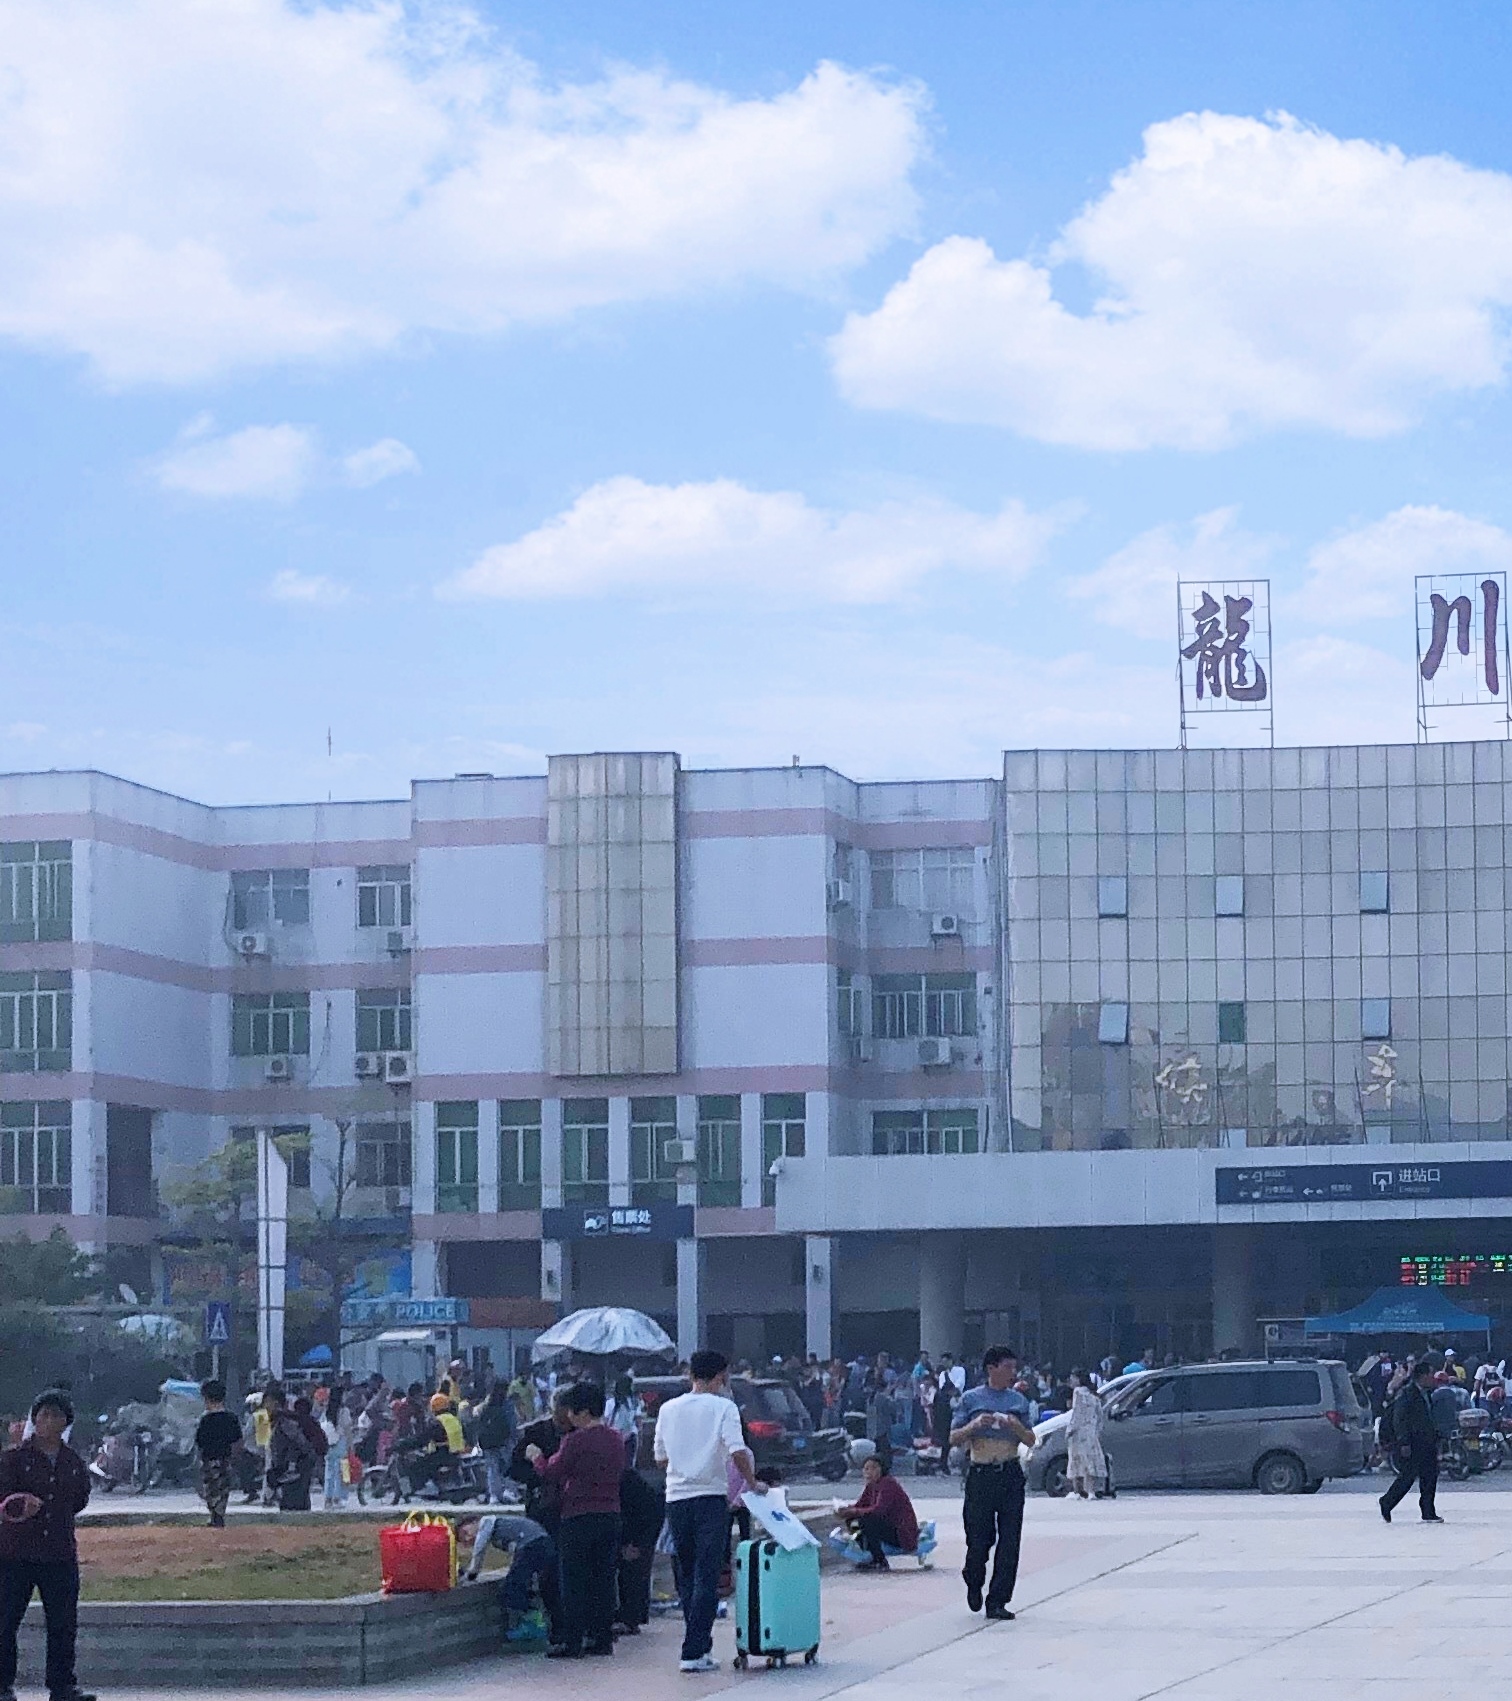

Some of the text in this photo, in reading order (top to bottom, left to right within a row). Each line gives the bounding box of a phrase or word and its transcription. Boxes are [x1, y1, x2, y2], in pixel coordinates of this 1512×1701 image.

[1399, 1167, 1440, 1182] 进站口
[612, 1209, 652, 1225] 售票处
[396, 1303, 455, 1319] POLICE
